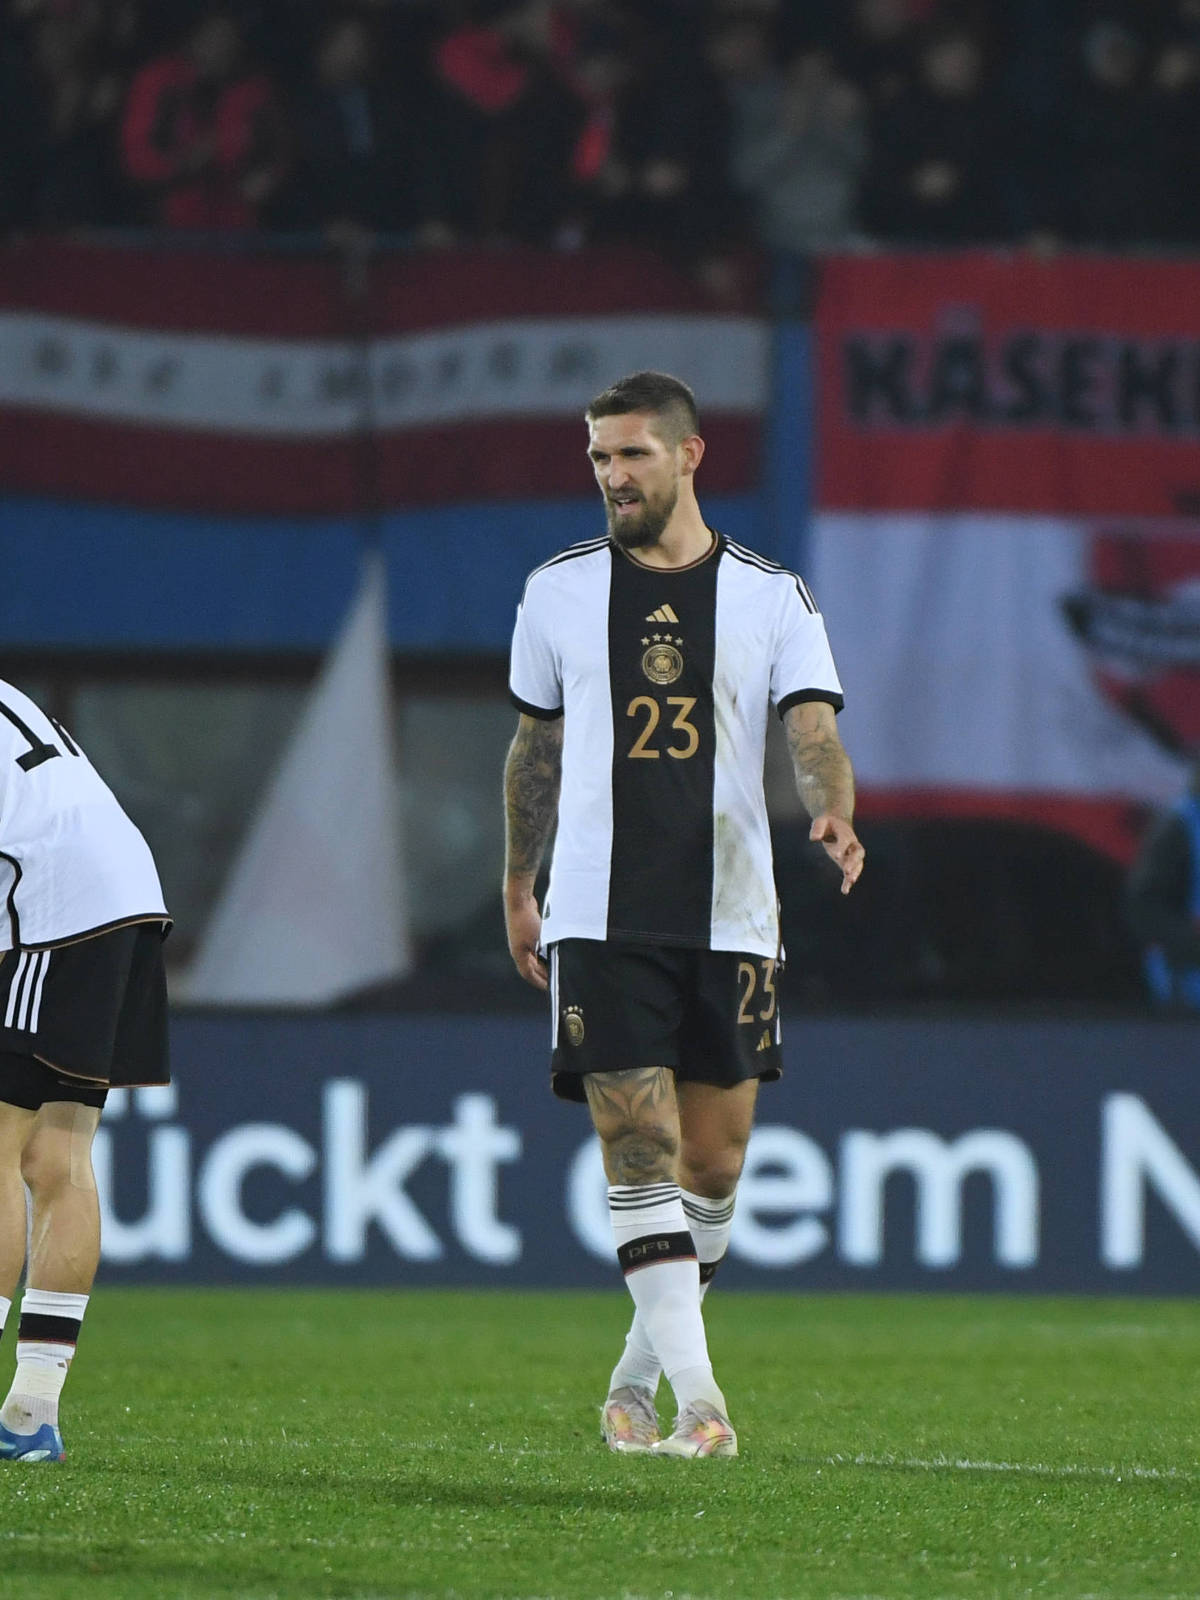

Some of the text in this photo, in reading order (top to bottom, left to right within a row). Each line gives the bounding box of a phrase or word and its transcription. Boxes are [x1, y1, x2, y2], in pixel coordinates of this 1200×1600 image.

[843, 303, 1200, 428] KÄSEK
[626, 695, 700, 759] 23
[737, 959, 776, 1024] 23
[628, 1240, 671, 1259] DFB
